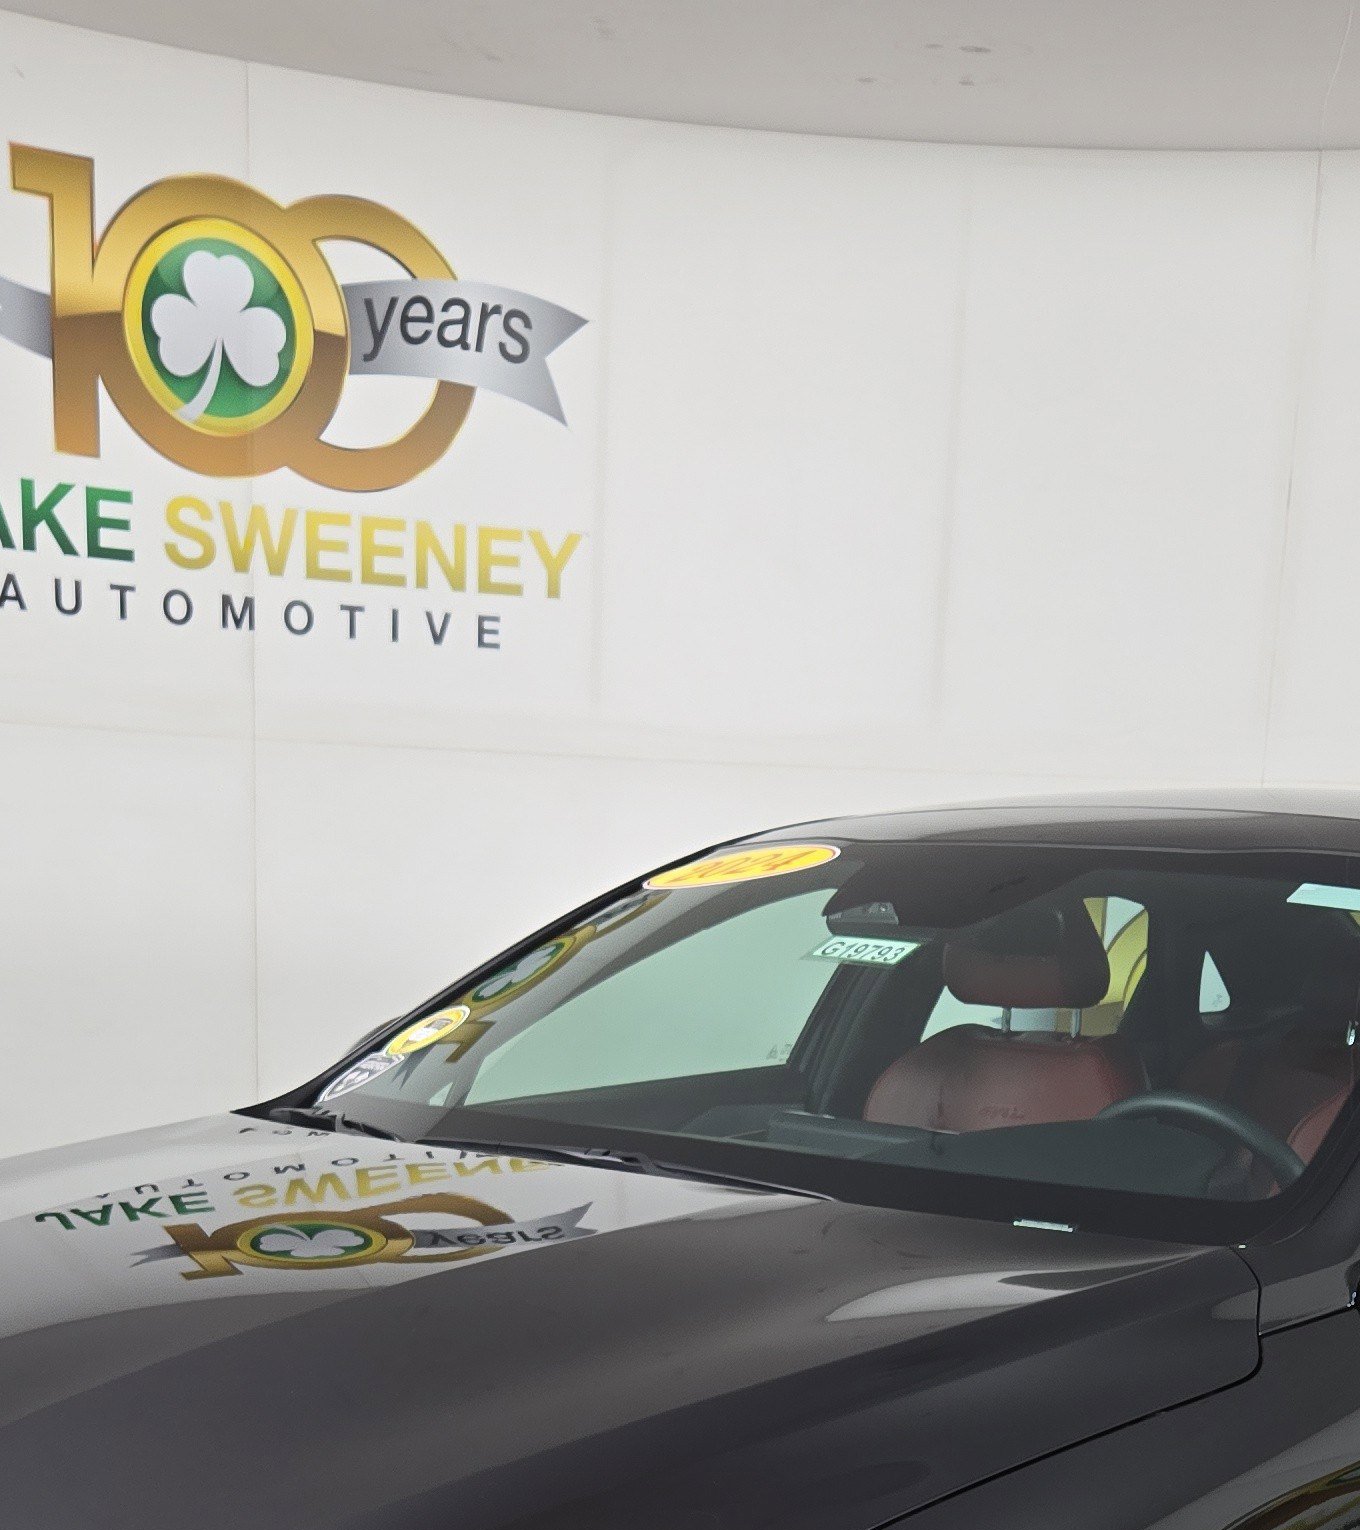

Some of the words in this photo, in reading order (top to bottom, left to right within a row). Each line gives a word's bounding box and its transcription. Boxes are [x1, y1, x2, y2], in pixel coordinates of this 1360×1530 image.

[361, 291, 534, 364] years
[163, 494, 583, 600] SWEENEY
[821, 941, 906, 962] G19793
